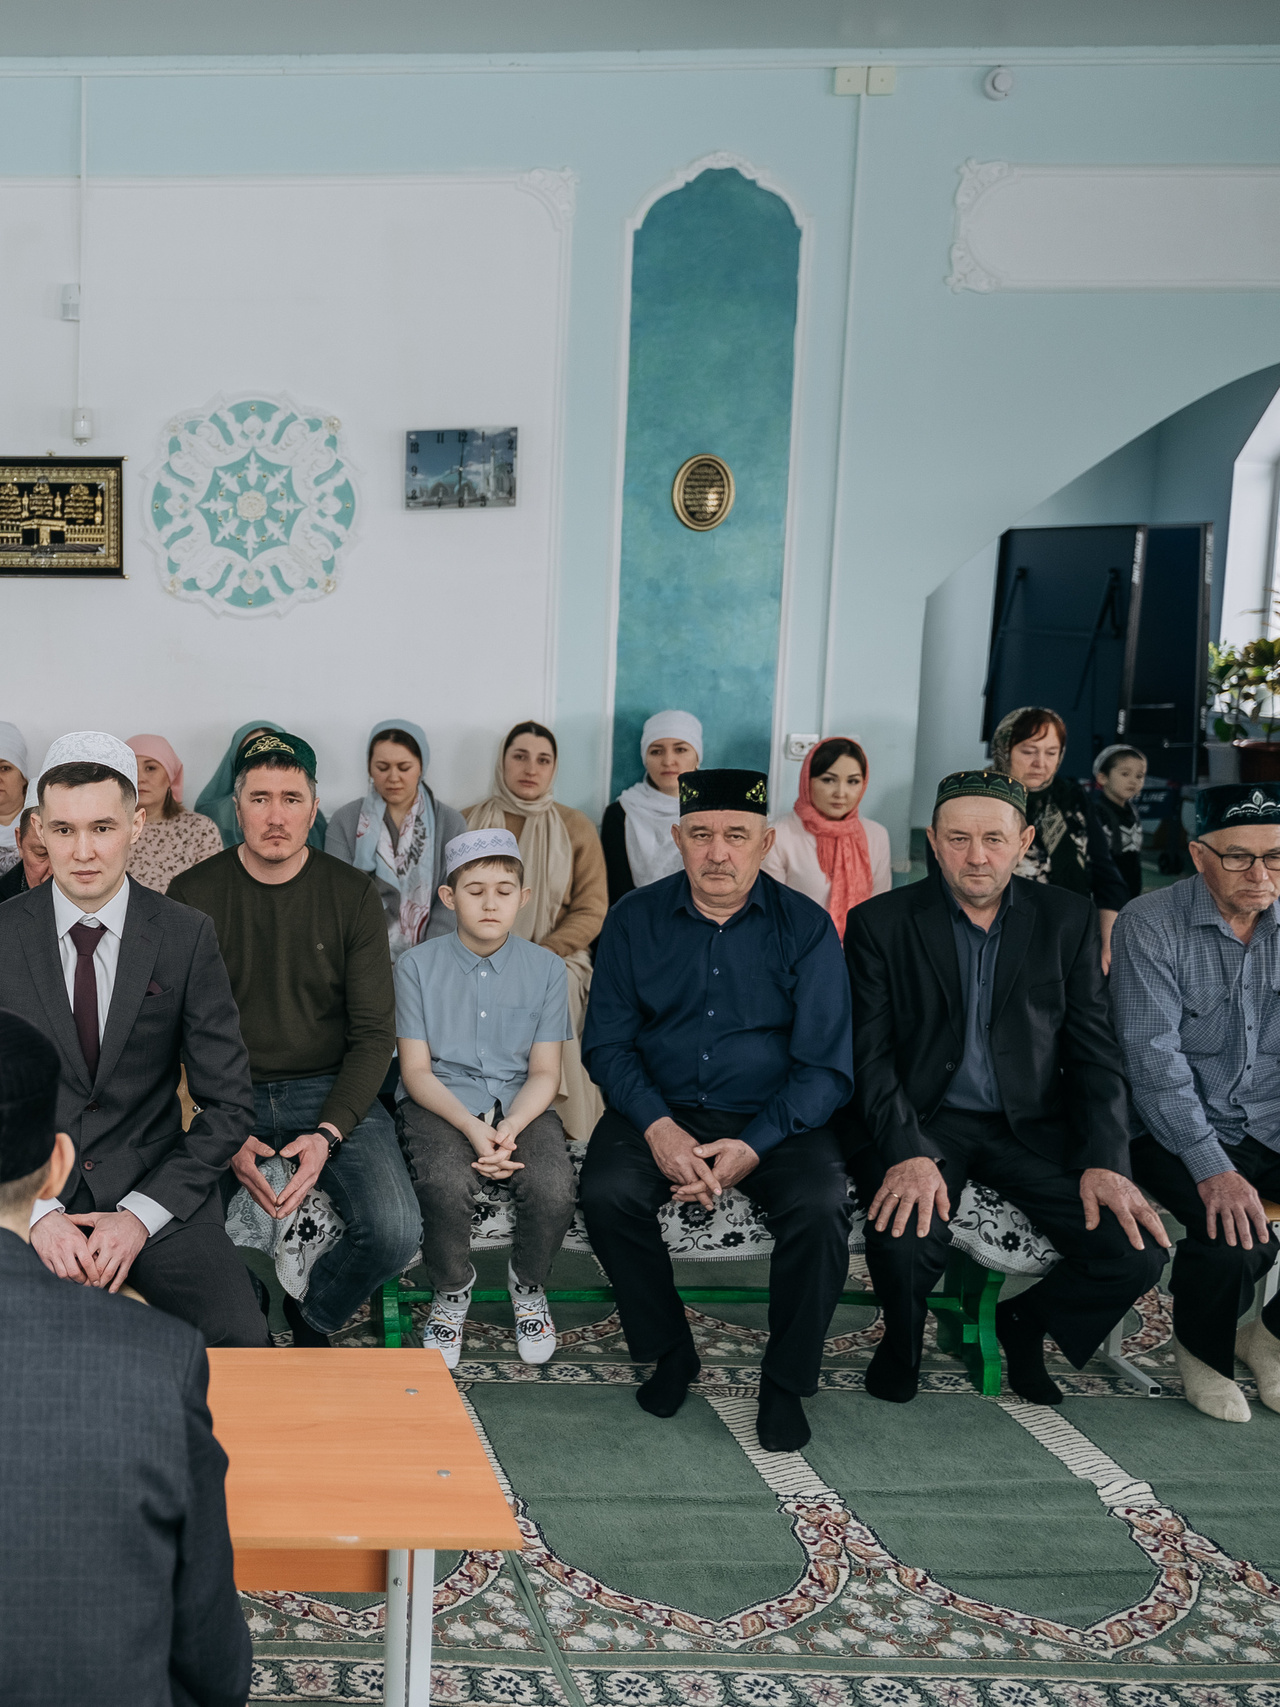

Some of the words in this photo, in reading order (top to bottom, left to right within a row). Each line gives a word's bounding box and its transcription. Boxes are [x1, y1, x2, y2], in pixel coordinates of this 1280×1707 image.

[436, 432, 445, 444] 11
[458, 431, 468, 443] 12
[481, 431, 485, 442] 1
[410, 442, 420, 454] 10
[507, 439, 514, 450] 2
[411, 465, 418, 477] 9
[506, 462, 514, 475] 3
